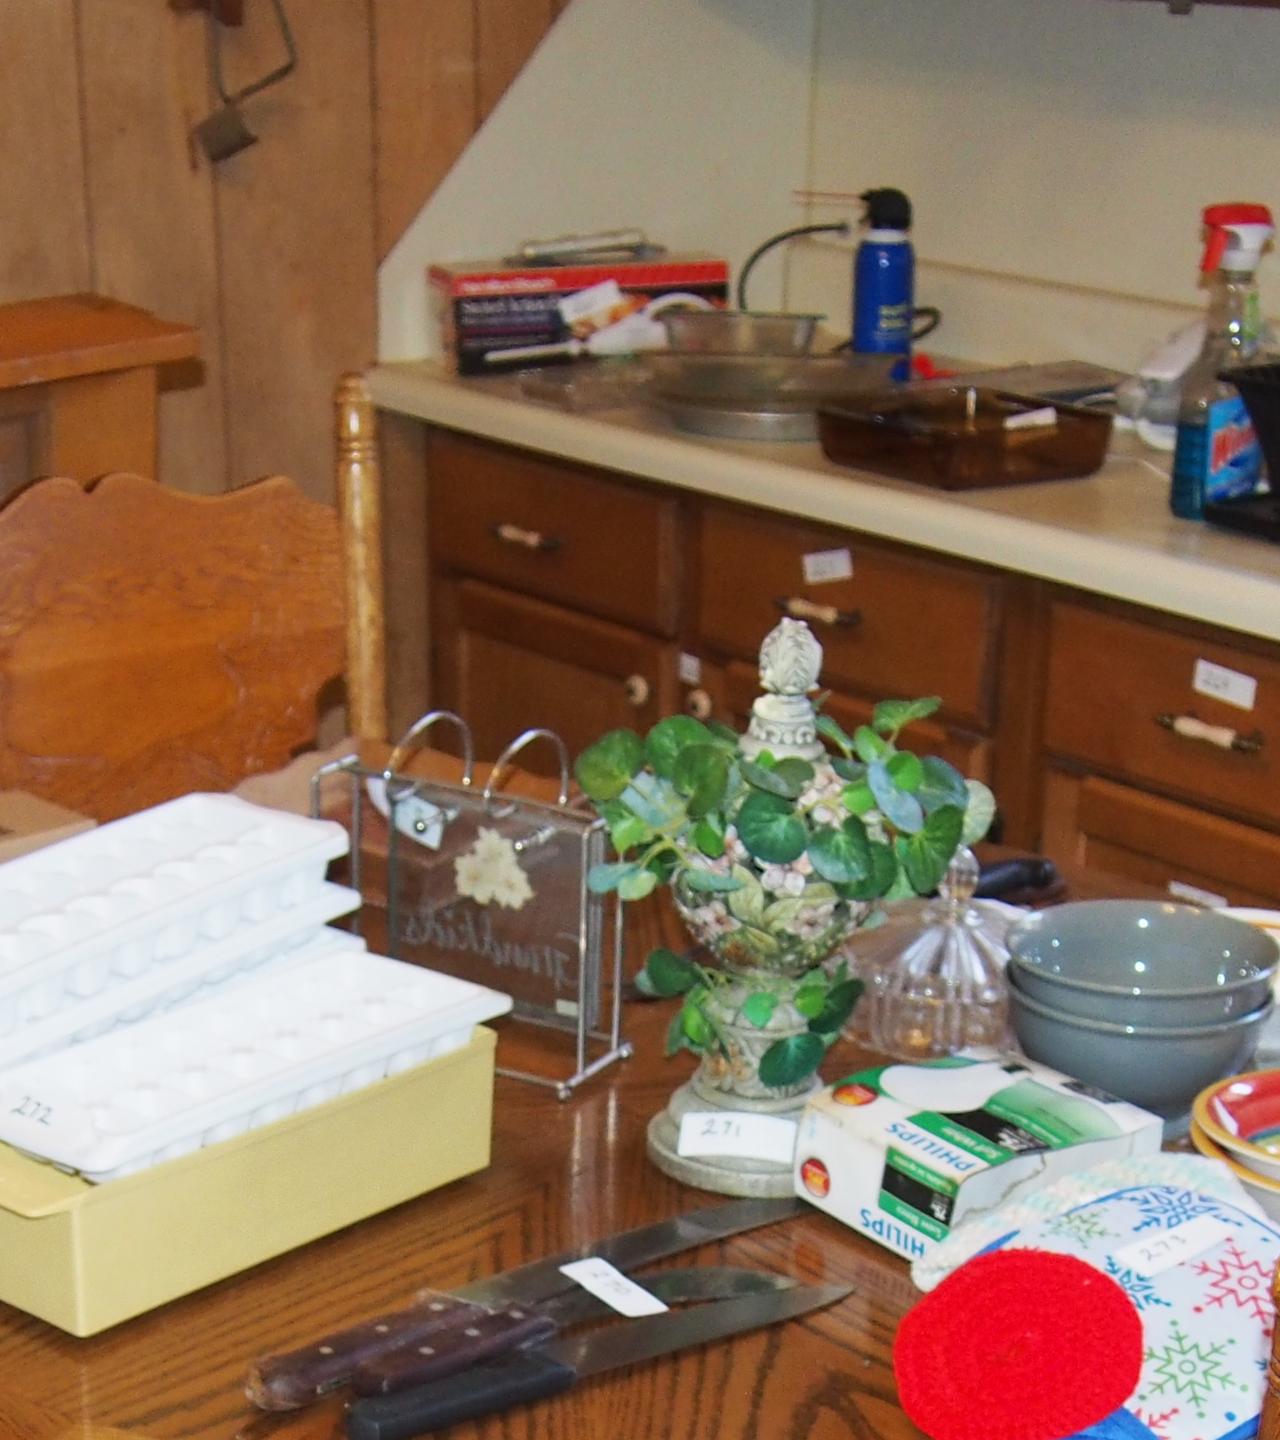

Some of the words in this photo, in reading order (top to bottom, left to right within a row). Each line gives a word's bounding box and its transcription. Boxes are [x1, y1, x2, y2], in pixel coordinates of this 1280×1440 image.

[10, 1094, 53, 1127] 272
[700, 1117, 742, 1138] 271
[884, 1121, 977, 1172] PHILIPS
[860, 1208, 926, 1259] HILIPS
